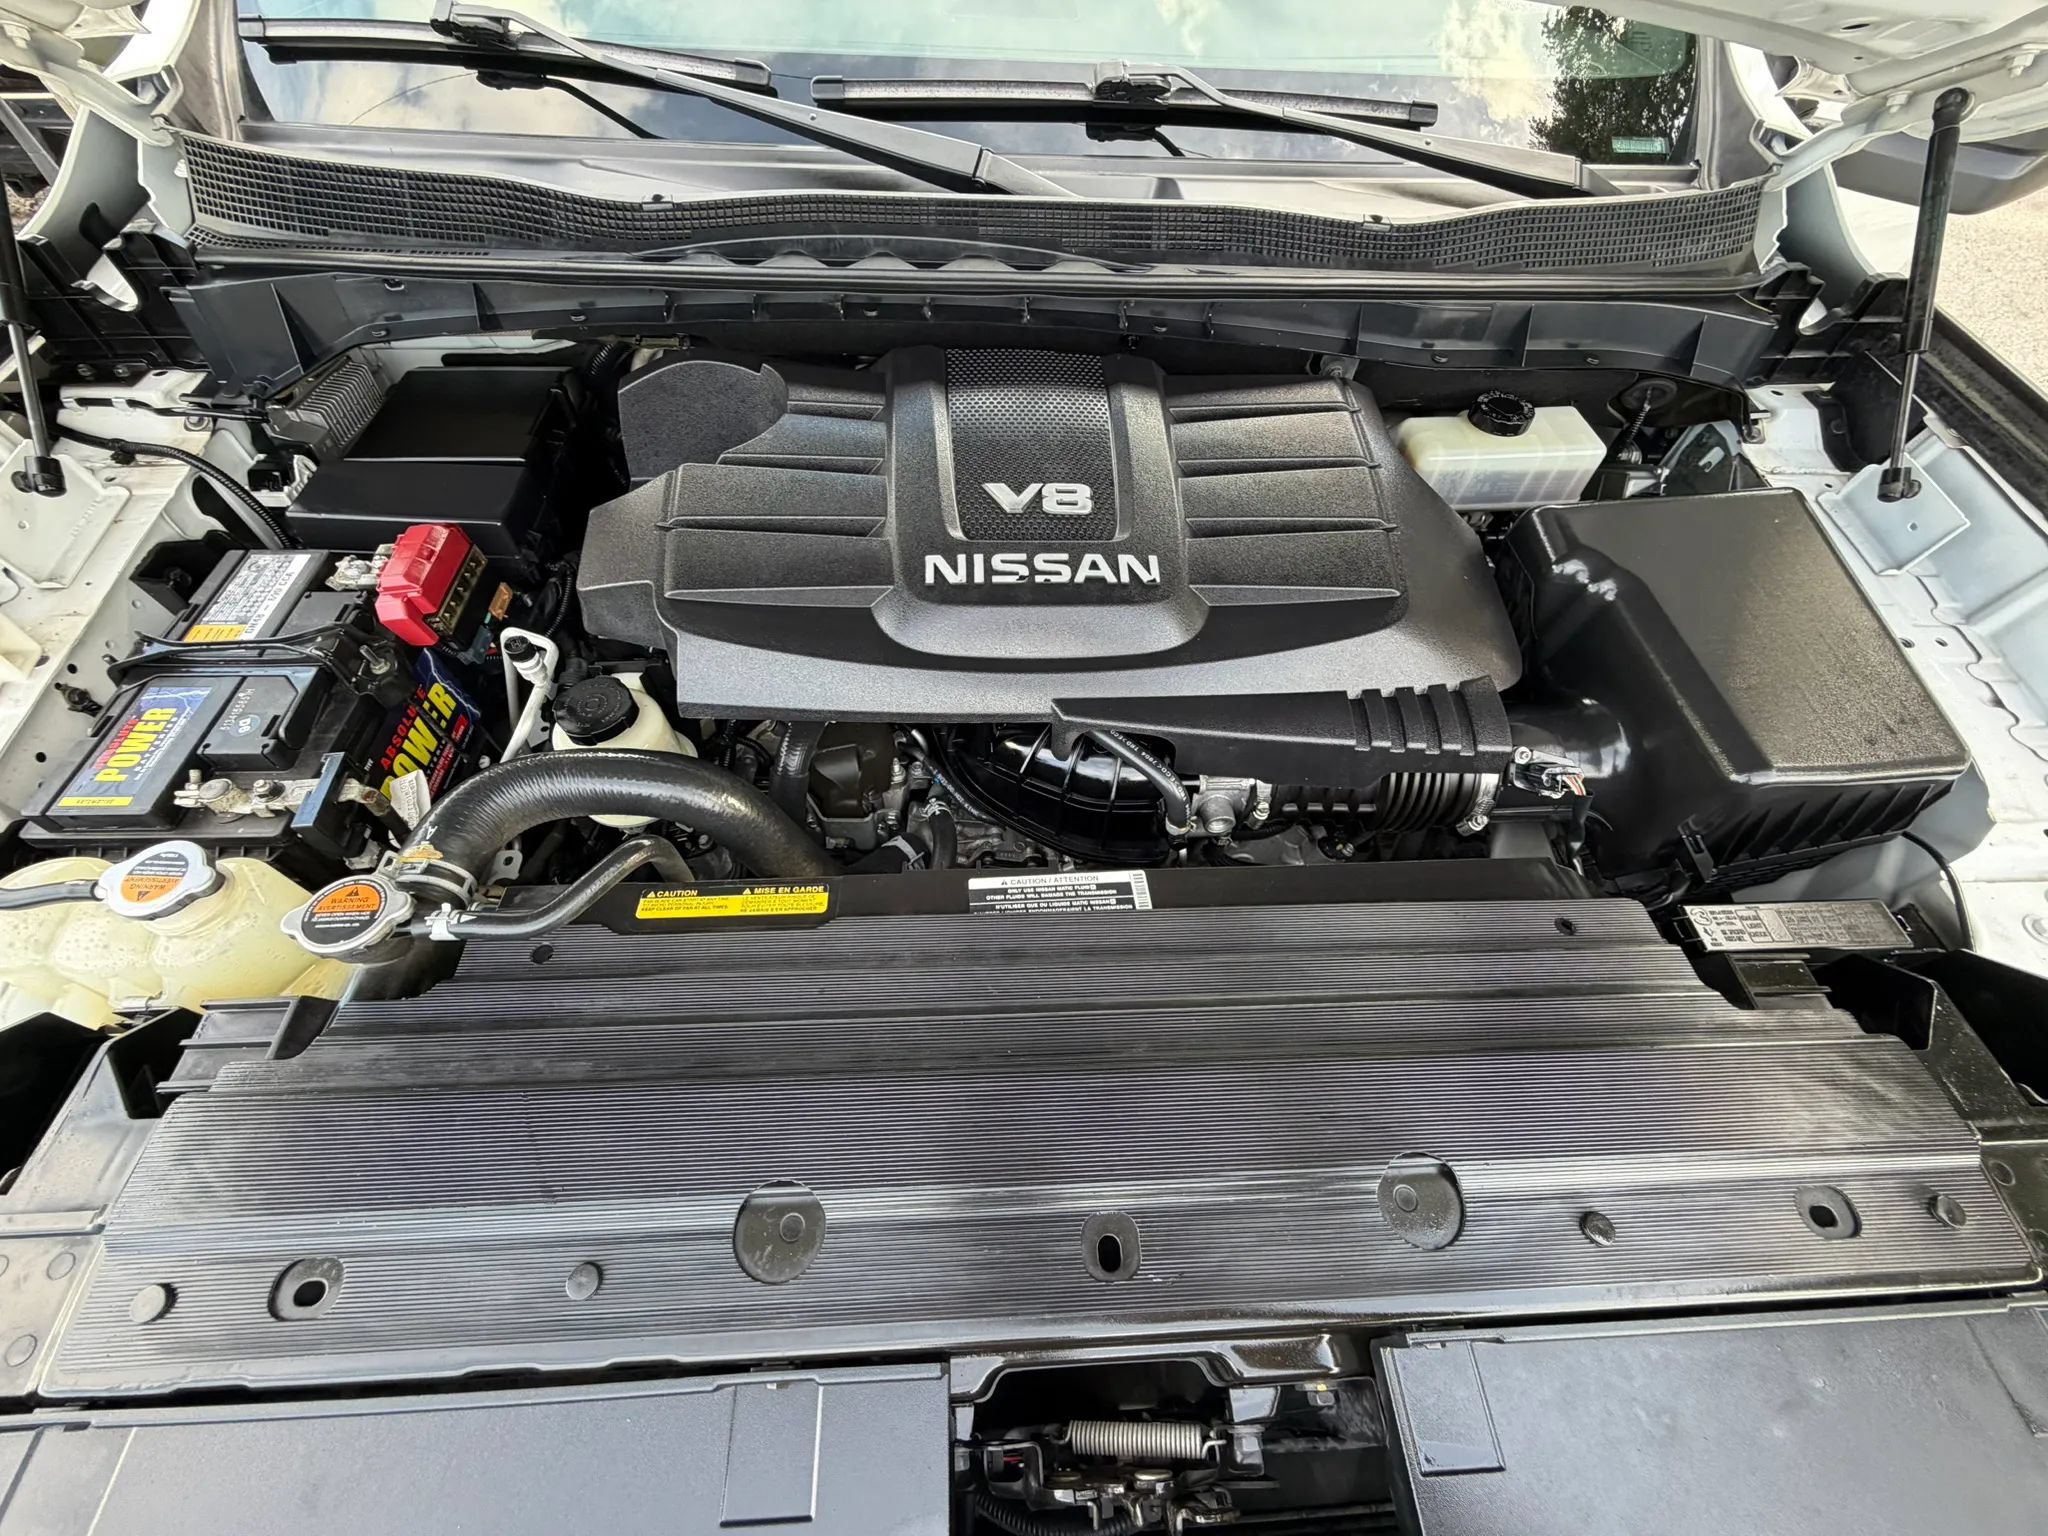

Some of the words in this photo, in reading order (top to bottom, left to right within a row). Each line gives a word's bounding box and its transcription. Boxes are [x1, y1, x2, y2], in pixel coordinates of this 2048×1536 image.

[981, 482, 1093, 515] V8
[925, 553, 1160, 585] NISSAN
[380, 685, 427, 770] ABSOLUE
[94, 708, 177, 782] POWER
[657, 889, 698, 898] CAUTION
[778, 886, 791, 894] EN
[792, 885, 825, 893] GARDE
[1010, 877, 1047, 885] CAUTION
[1053, 875, 1099, 883] ATTENTION
